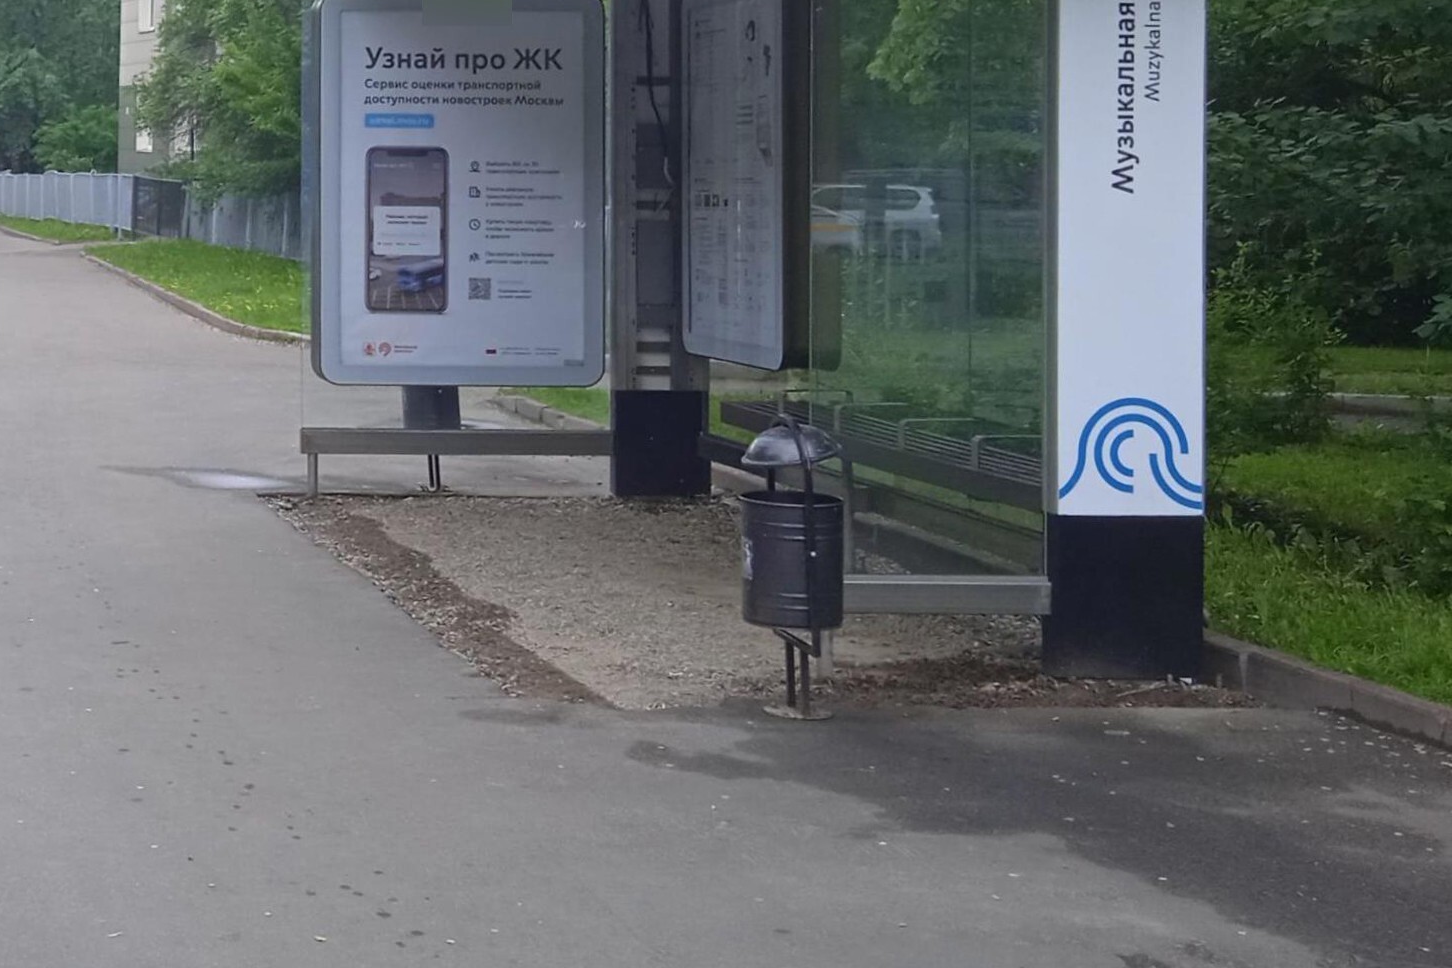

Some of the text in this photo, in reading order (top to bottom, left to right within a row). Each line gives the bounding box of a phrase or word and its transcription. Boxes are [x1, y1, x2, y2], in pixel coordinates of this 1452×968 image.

[365, 46, 563, 74] Узнай про ЖК
[364, 78, 542, 92] Сервис оценки транспортной
[363, 94, 564, 107] доступности новостроек Москвы
[1111, 1, 1140, 194] Музыкальная
